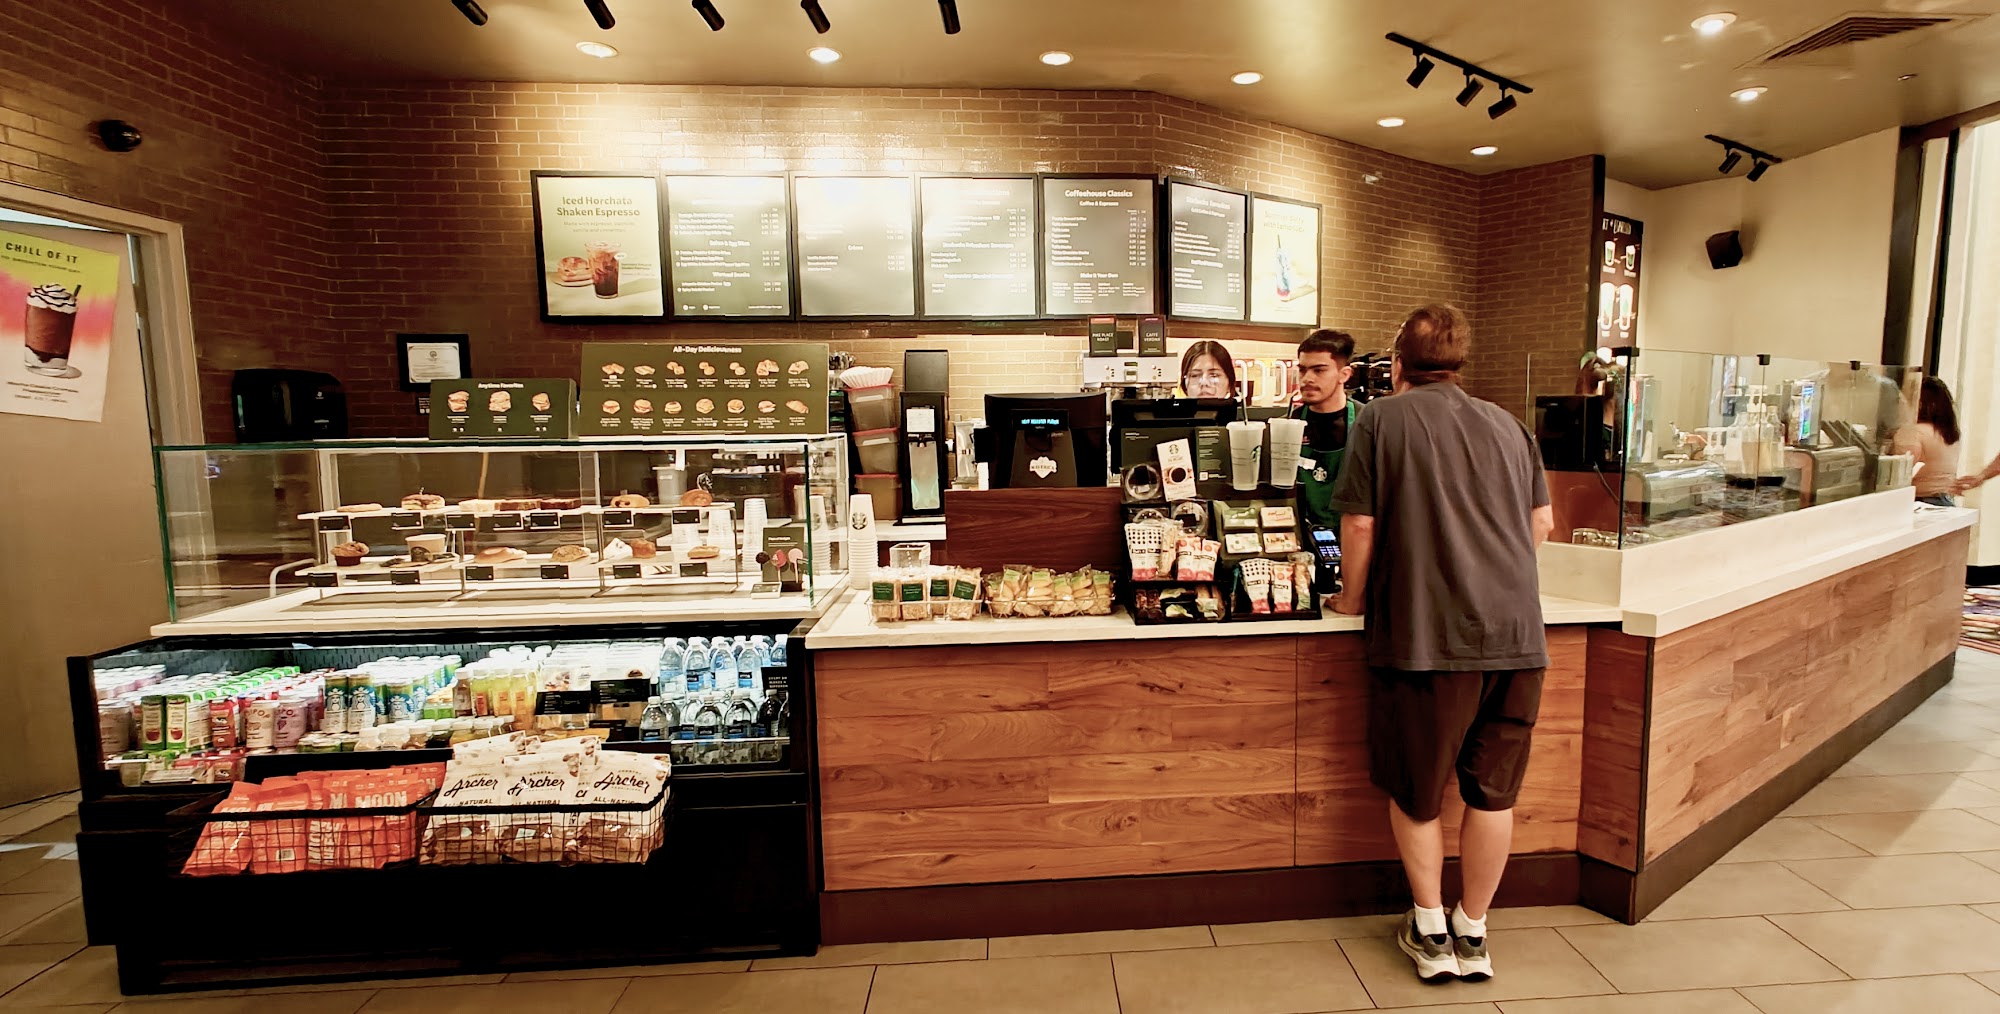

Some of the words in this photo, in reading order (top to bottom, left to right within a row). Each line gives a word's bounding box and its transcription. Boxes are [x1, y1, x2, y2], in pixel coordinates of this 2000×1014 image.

[562, 196, 584, 205] Iced
[585, 196, 633, 205] Horchata
[1064, 189, 1107, 197] Coffeehouse
[1107, 189, 1133, 197] Classics
[556, 207, 594, 216] Shaken
[595, 207, 640, 218] Espresso
[5, 242, 41, 257] CHILL
[47, 250, 61, 260] OF
[66, 255, 78, 264] IT
[672, 345, 698, 354] All-Day
[698, 345, 742, 354] Deliciousness
[443, 777, 498, 799] Archer
[507, 776, 565, 797] Archer
[594, 771, 650, 794] Archer
[355, 790, 408, 808] MOON
